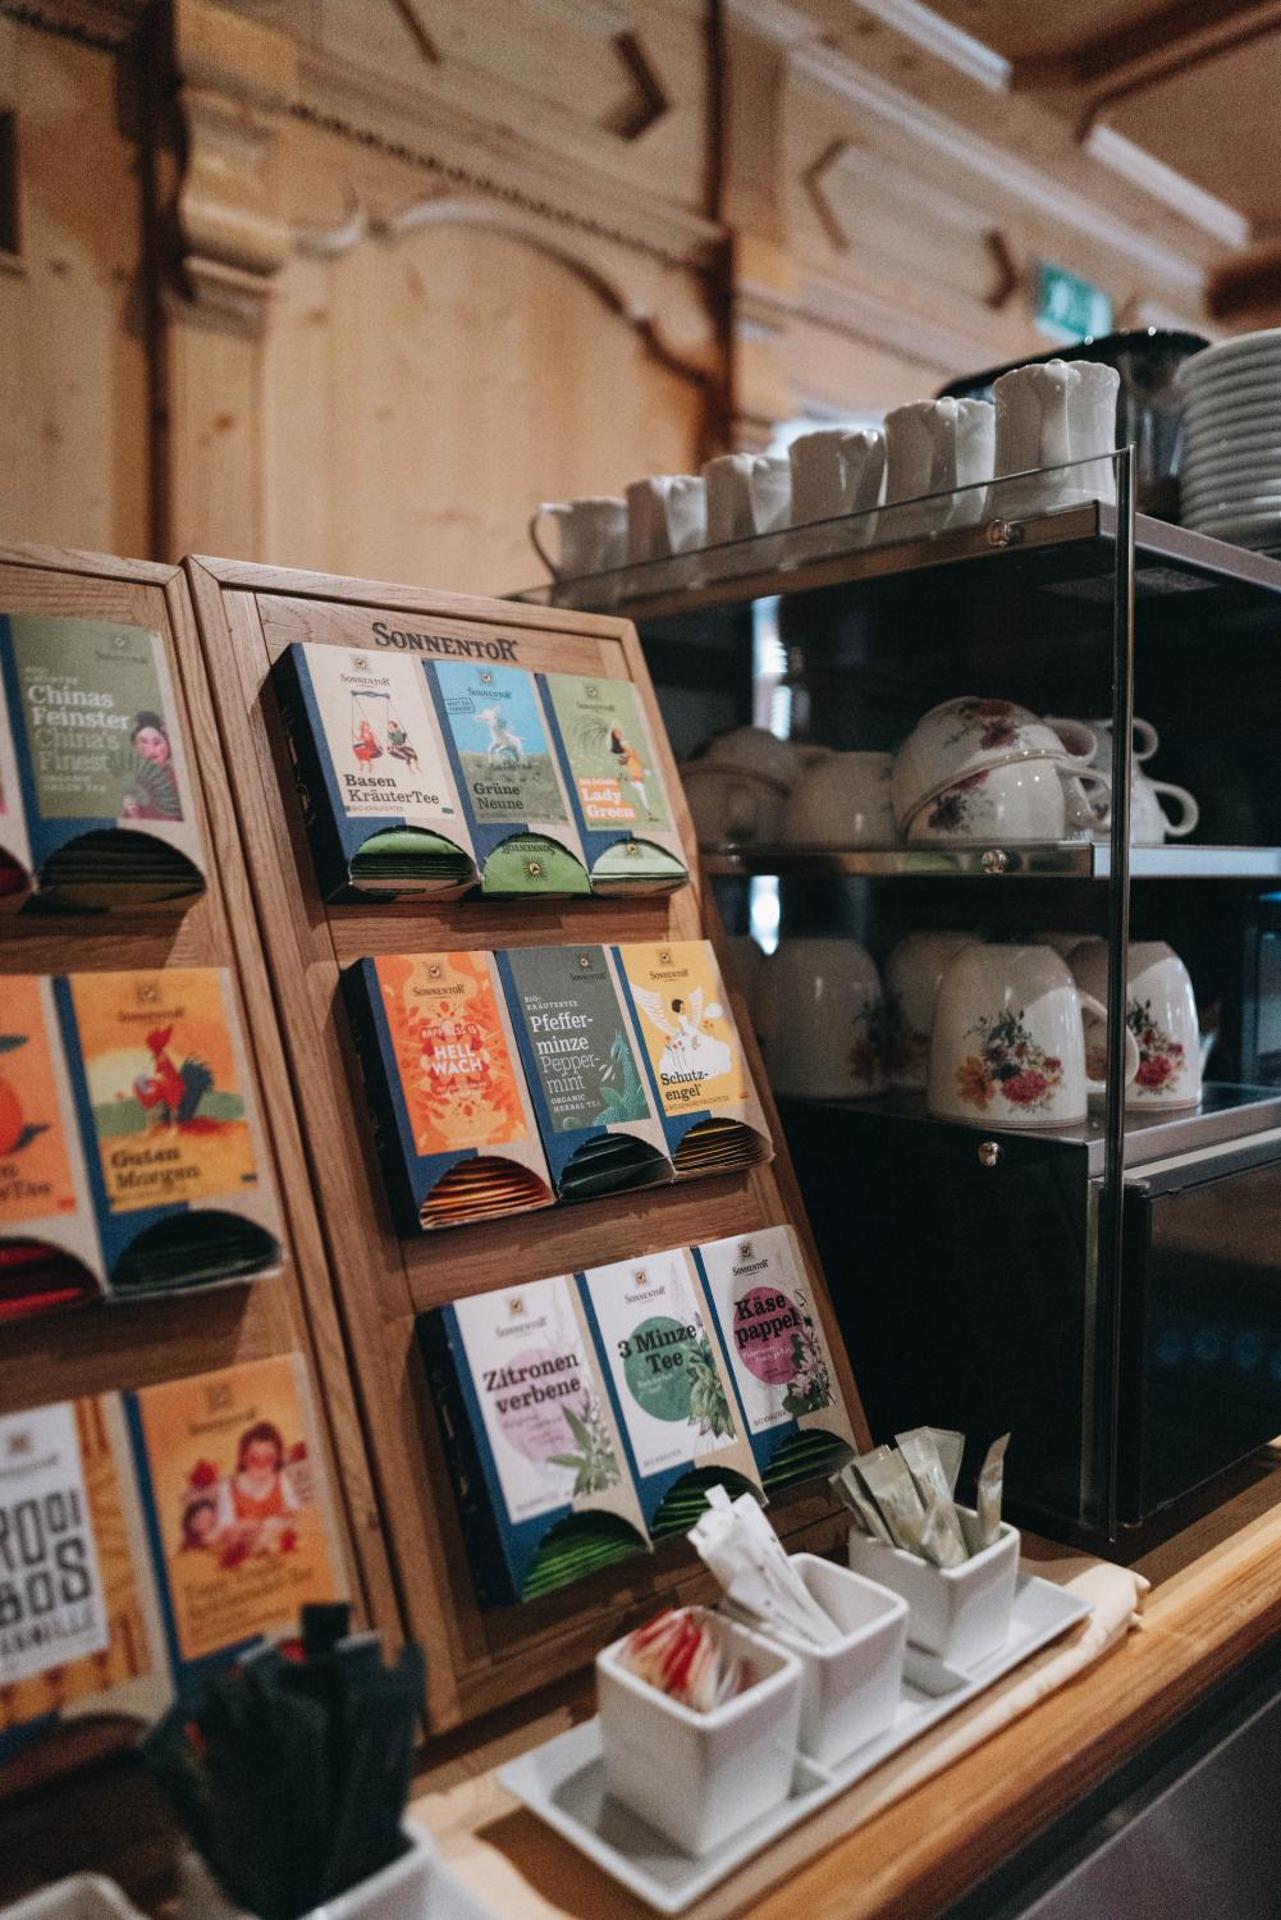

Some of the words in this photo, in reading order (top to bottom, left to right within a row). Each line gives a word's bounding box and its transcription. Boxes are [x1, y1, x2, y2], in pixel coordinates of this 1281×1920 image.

[372, 621, 518, 662] SONNENTOR
[28, 684, 114, 707] Chinas
[32, 707, 131, 729] Feinster
[344, 774, 397, 788] Basen
[473, 782, 520, 795] Grüne
[348, 789, 440, 805] KräuterTee
[477, 797, 524, 810] Neune
[581, 786, 622, 804] Lady
[587, 804, 635, 818] Green
[530, 1012, 594, 1033] Pfeffer-
[433, 1043, 476, 1061] HELL
[536, 1036, 590, 1055] minze
[431, 1059, 483, 1077] WACH
[541, 1053, 600, 1077] Pepper-
[546, 1074, 586, 1094] mint
[660, 1068, 708, 1086] Schutz-
[551, 1094, 586, 1104] ORGANIC
[553, 1102, 585, 1112] HERBAL
[111, 1148, 181, 1168] Guten
[115, 1166, 199, 1190] Morgen
[734, 1293, 787, 1321] Käse
[734, 1308, 800, 1349] pappel
[618, 1340, 633, 1359] 3
[635, 1324, 697, 1353] Minze
[483, 1353, 580, 1392] Zitronen
[645, 1352, 684, 1374] Tee
[496, 1377, 581, 1414] verbene
